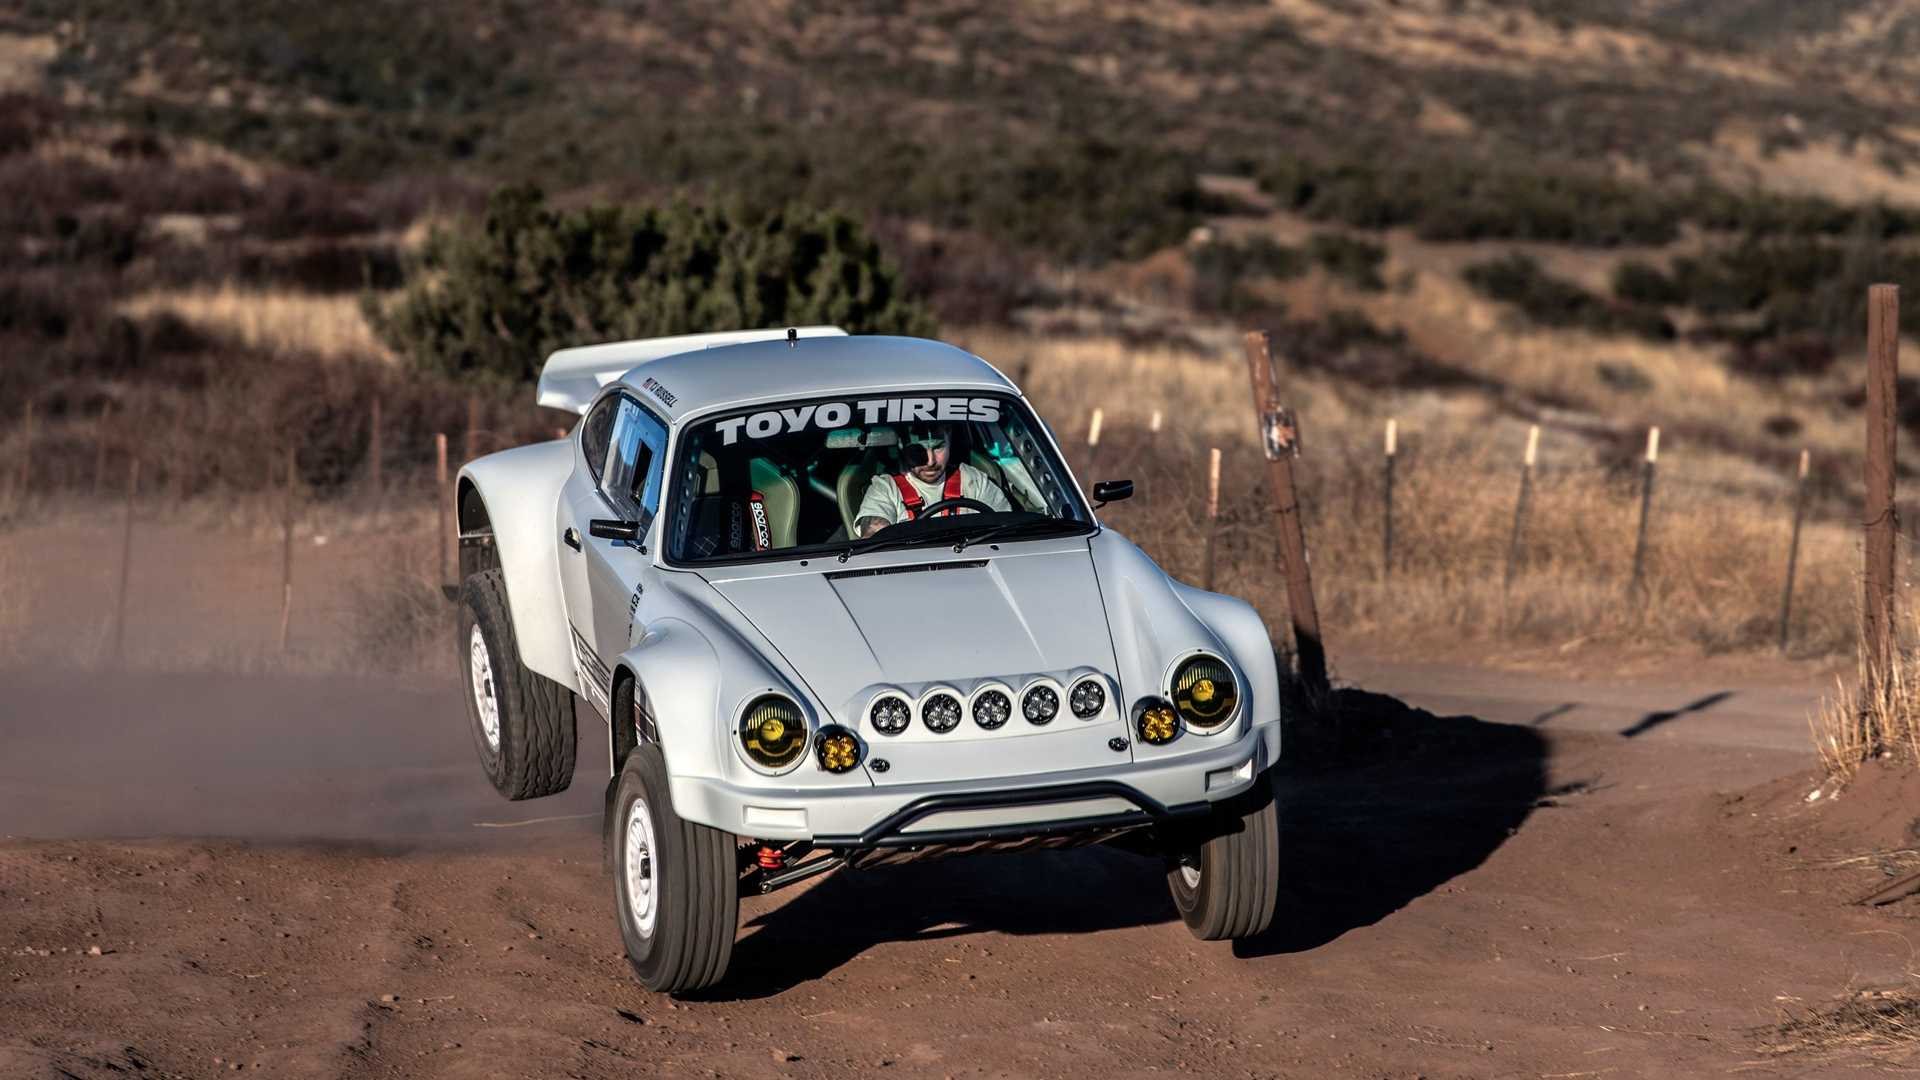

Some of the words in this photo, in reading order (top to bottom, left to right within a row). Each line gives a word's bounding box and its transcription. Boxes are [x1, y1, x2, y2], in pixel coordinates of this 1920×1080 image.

[715, 402, 851, 447] TOYO
[857, 397, 1000, 424] TIRES
[752, 502, 769, 548] sparco
